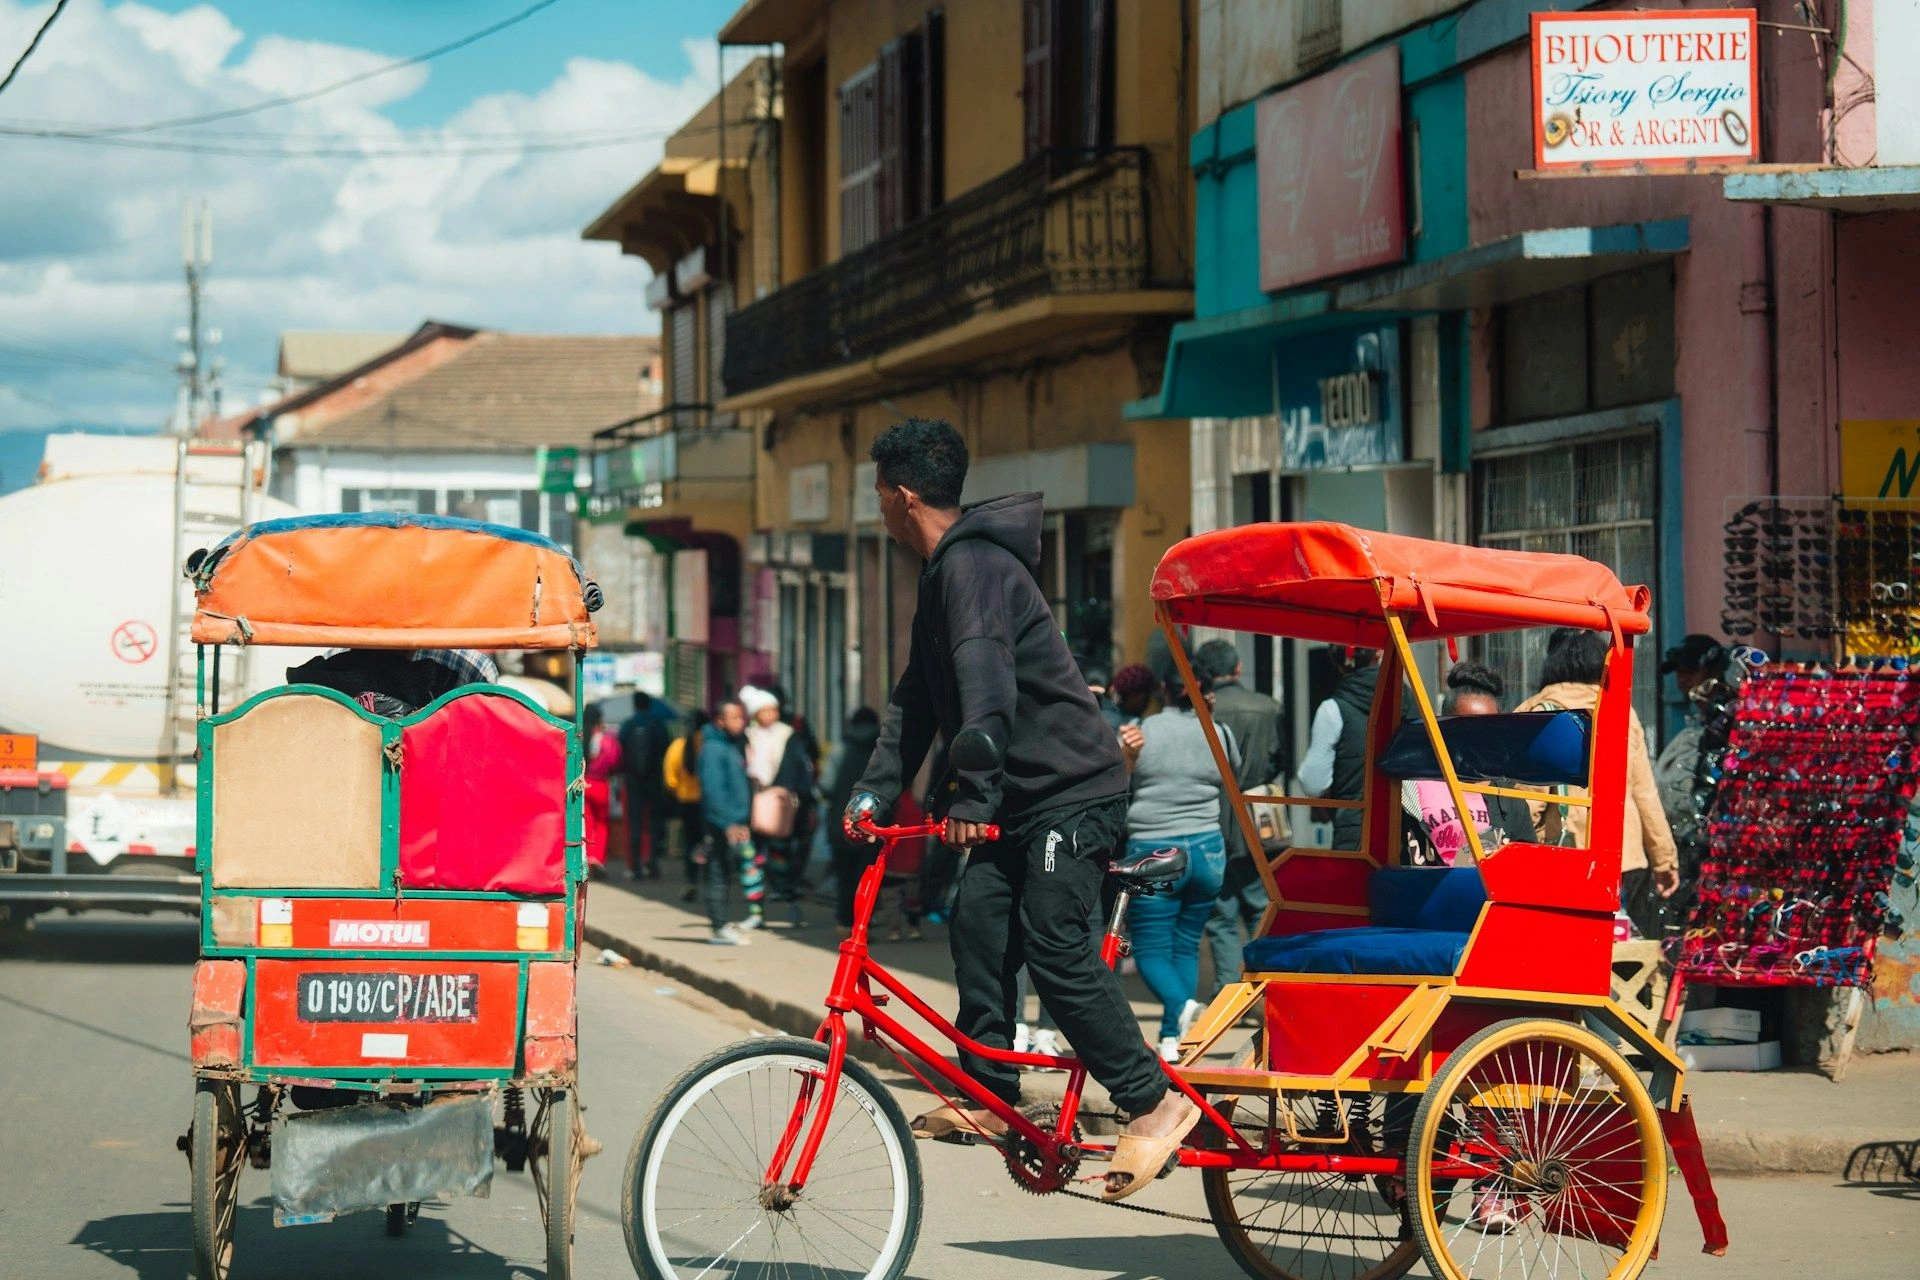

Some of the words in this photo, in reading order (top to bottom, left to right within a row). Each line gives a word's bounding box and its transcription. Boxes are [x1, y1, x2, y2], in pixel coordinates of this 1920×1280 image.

[1545, 31, 1747, 72] BIJOUTERIE
[1546, 72, 1637, 117] Tsiory
[1649, 71, 1747, 116] Sergio
[1570, 120, 1603, 148] OR
[1609, 120, 1626, 146] &
[1634, 117, 1723, 146] ARGENT
[334, 923, 425, 943] MOTUL
